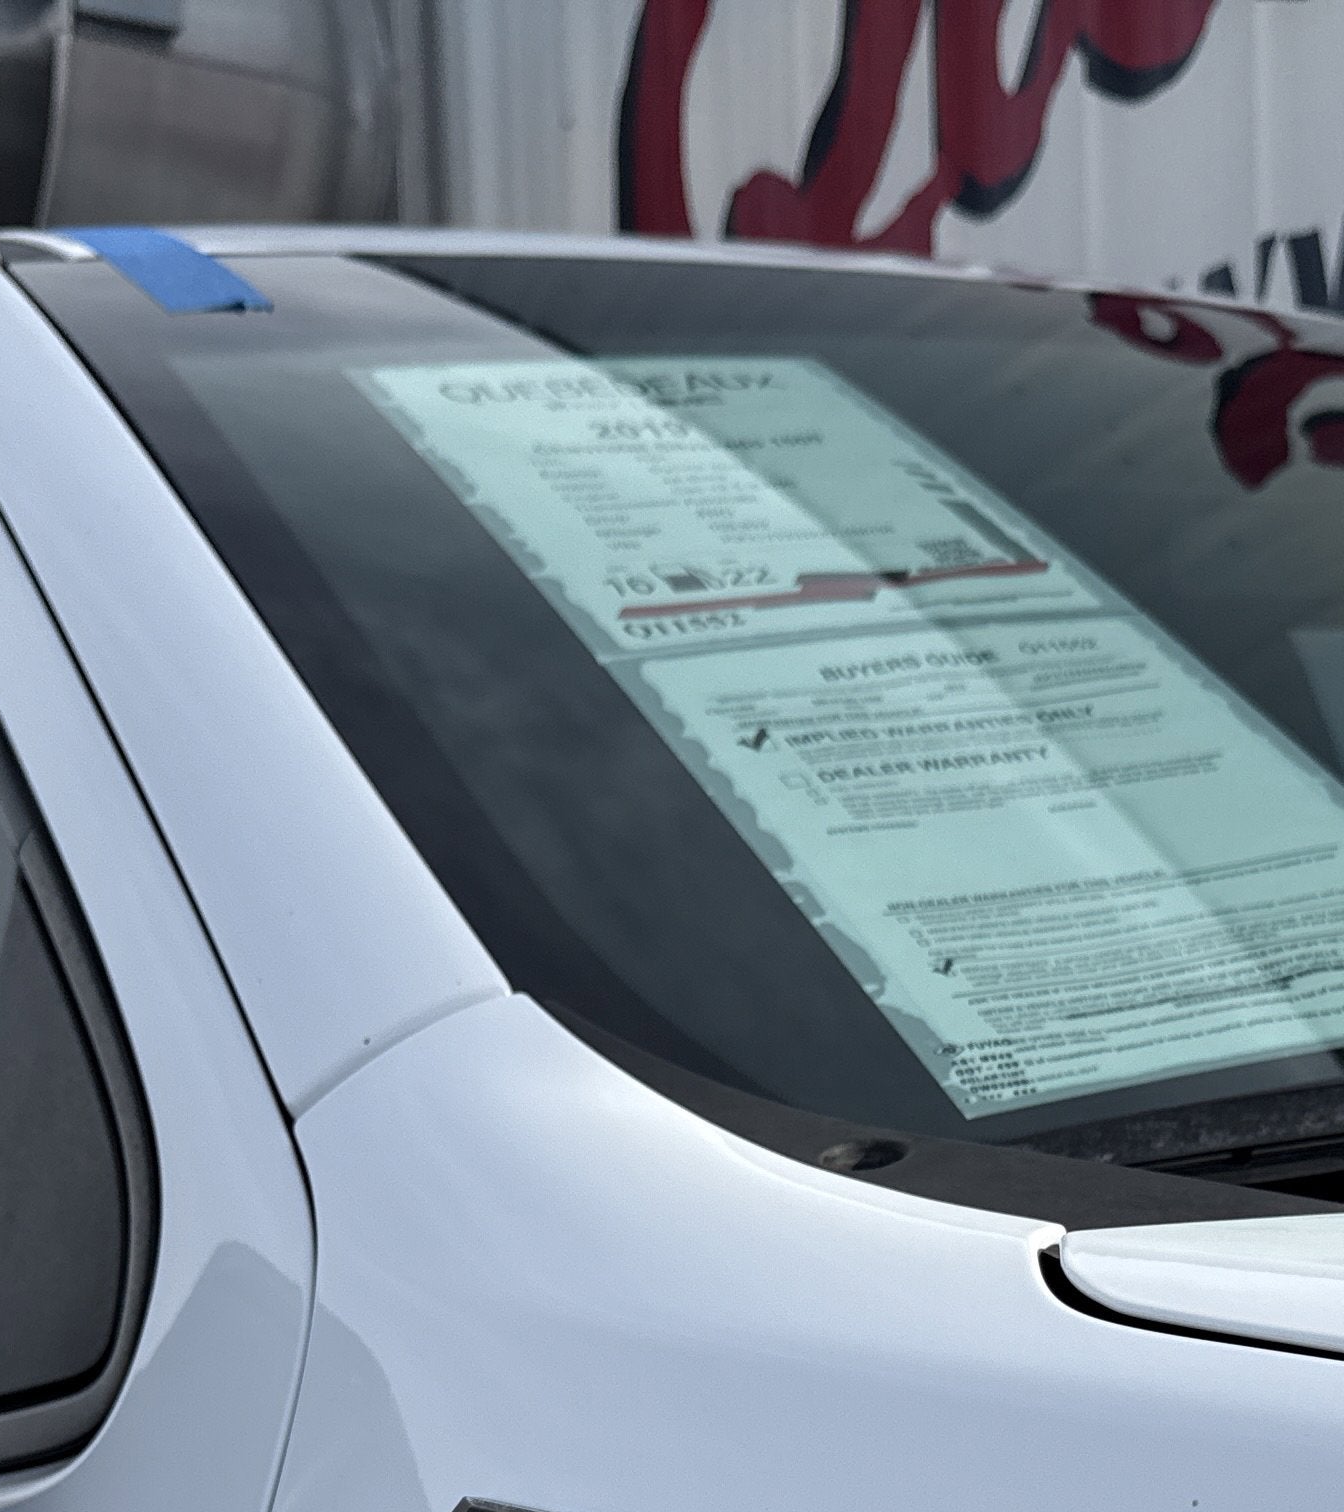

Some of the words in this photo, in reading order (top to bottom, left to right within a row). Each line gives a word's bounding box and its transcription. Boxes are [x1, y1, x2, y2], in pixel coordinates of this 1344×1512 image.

[819, 655, 921, 683] BUYERS
[925, 648, 1001, 668] GUIDE
[1035, 704, 1096, 724] ONLY
[817, 759, 914, 784] DEALER
[917, 745, 1049, 774] WARRANTY
